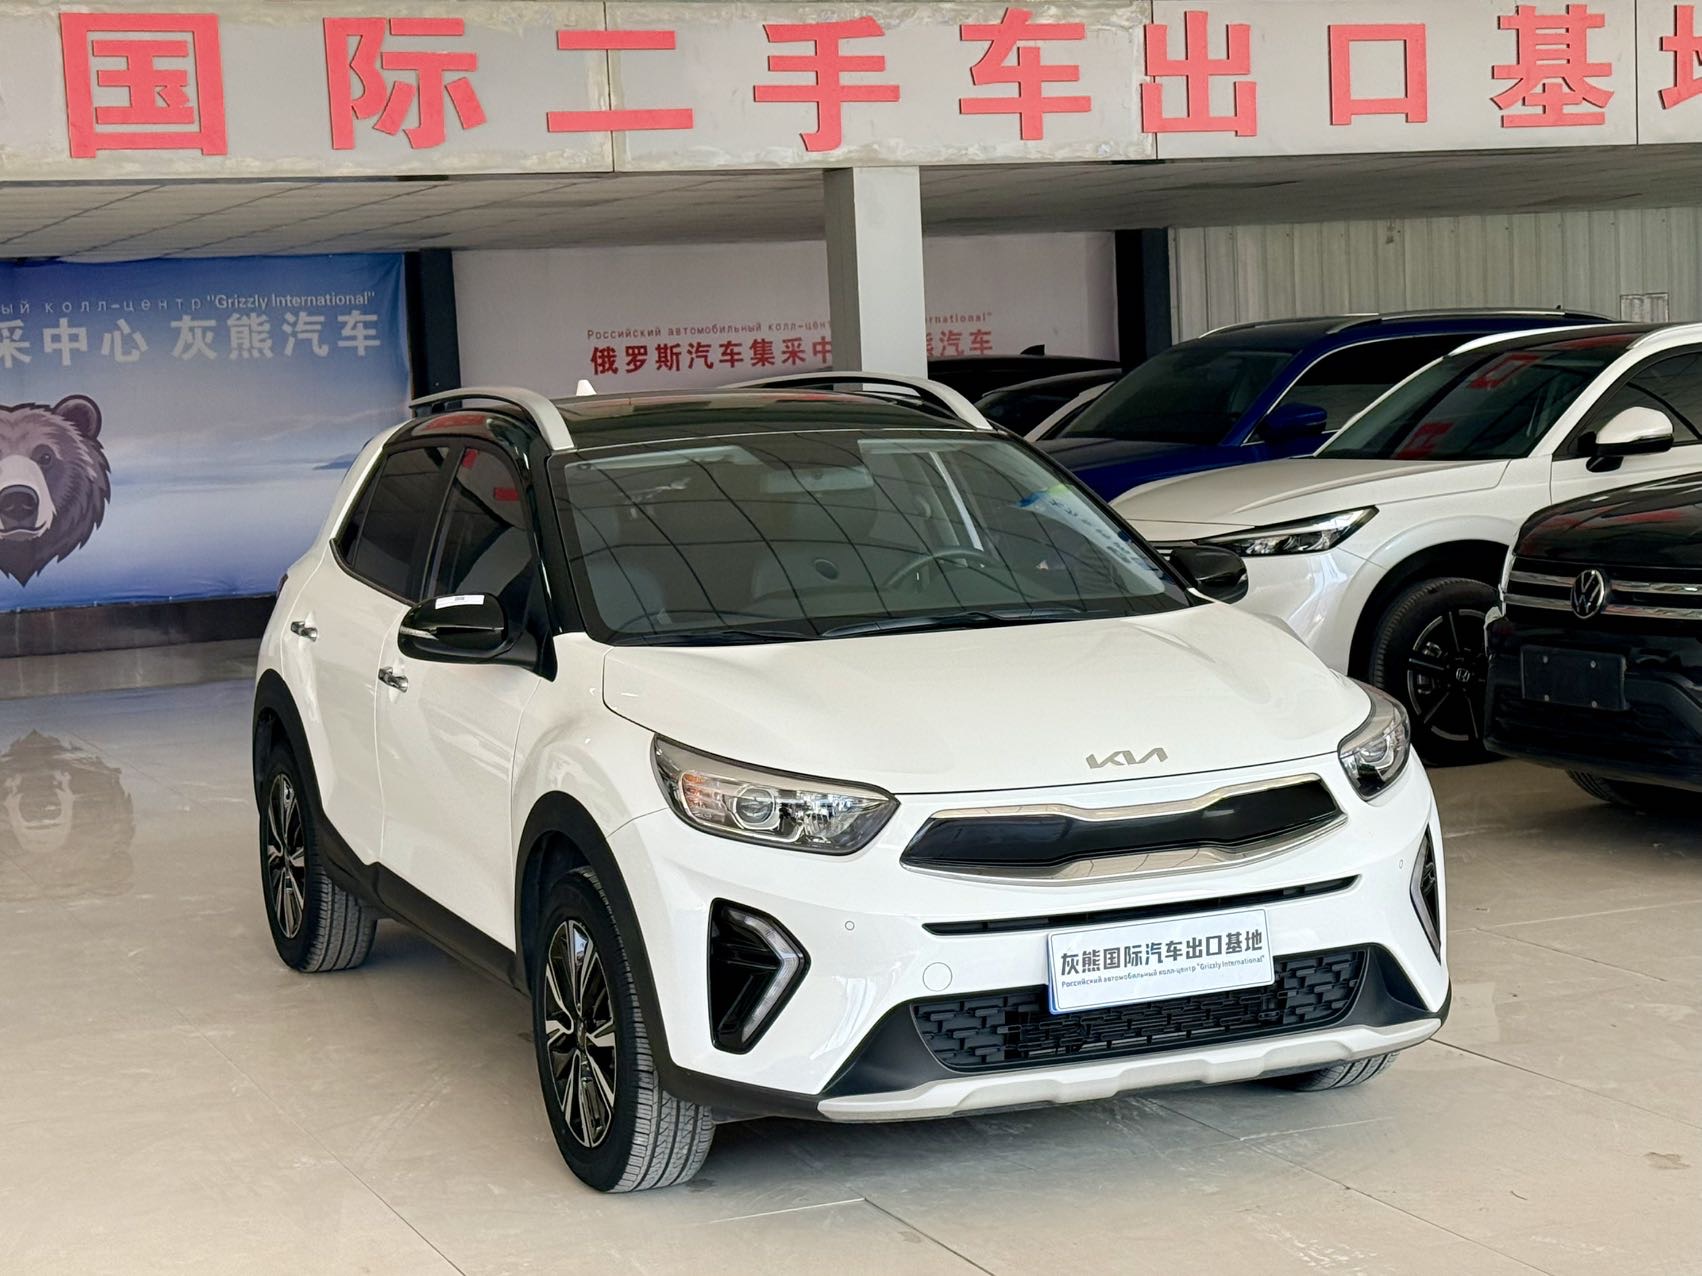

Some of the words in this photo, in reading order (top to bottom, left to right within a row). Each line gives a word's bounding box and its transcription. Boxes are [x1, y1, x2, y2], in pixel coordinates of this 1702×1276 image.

[45, 299, 201, 313] колл-центр
[207, 294, 268, 310] "Grizzly
[272, 291, 376, 308] International"
[587, 326, 661, 340] Российский
[668, 322, 761, 336] автомобильный
[925, 311, 992, 324] rnational"
[591, 336, 832, 375] 俄罗斯汽车集采中
[1061, 929, 1264, 976] 灰熊国际汽车出口基地
[1062, 976, 1102, 988] Российский
